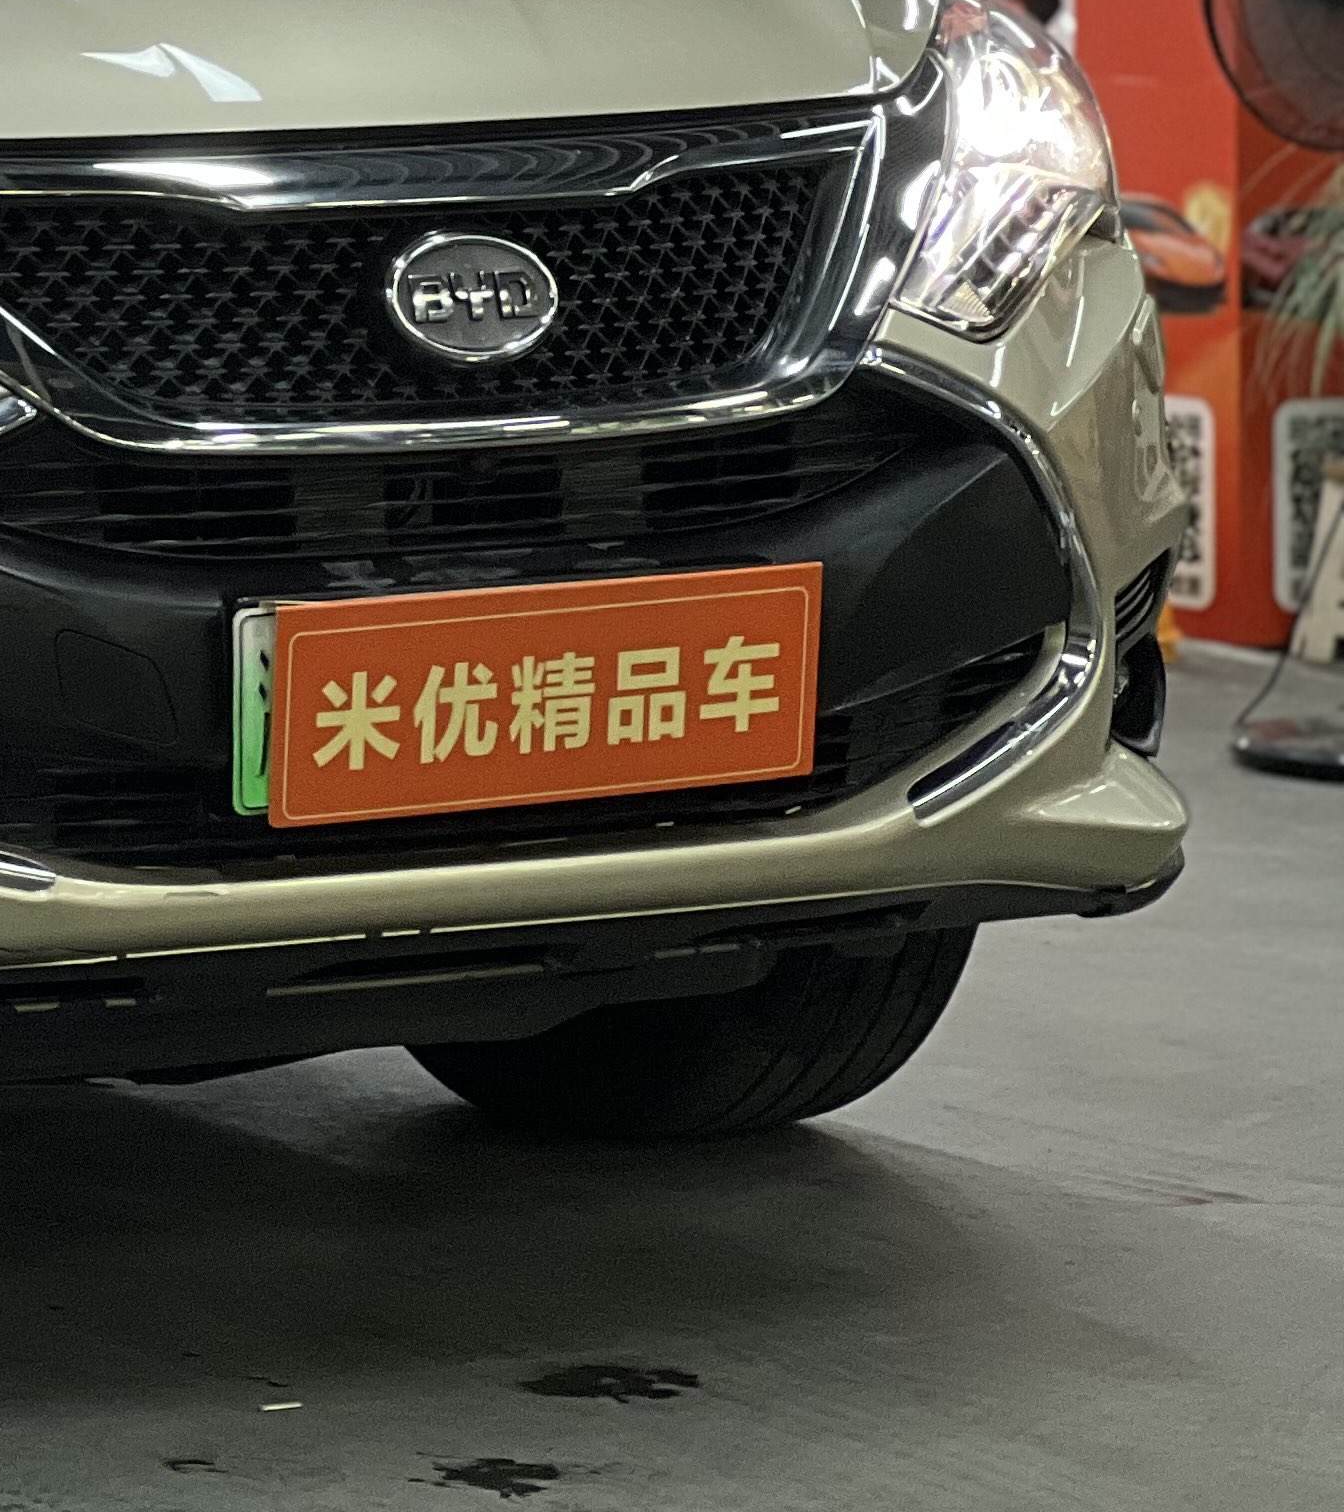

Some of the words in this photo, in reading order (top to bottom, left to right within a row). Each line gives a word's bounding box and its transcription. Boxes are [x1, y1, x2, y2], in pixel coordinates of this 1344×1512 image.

[408, 269, 541, 323] BYD
[312, 635, 782, 771] 米优精品车
